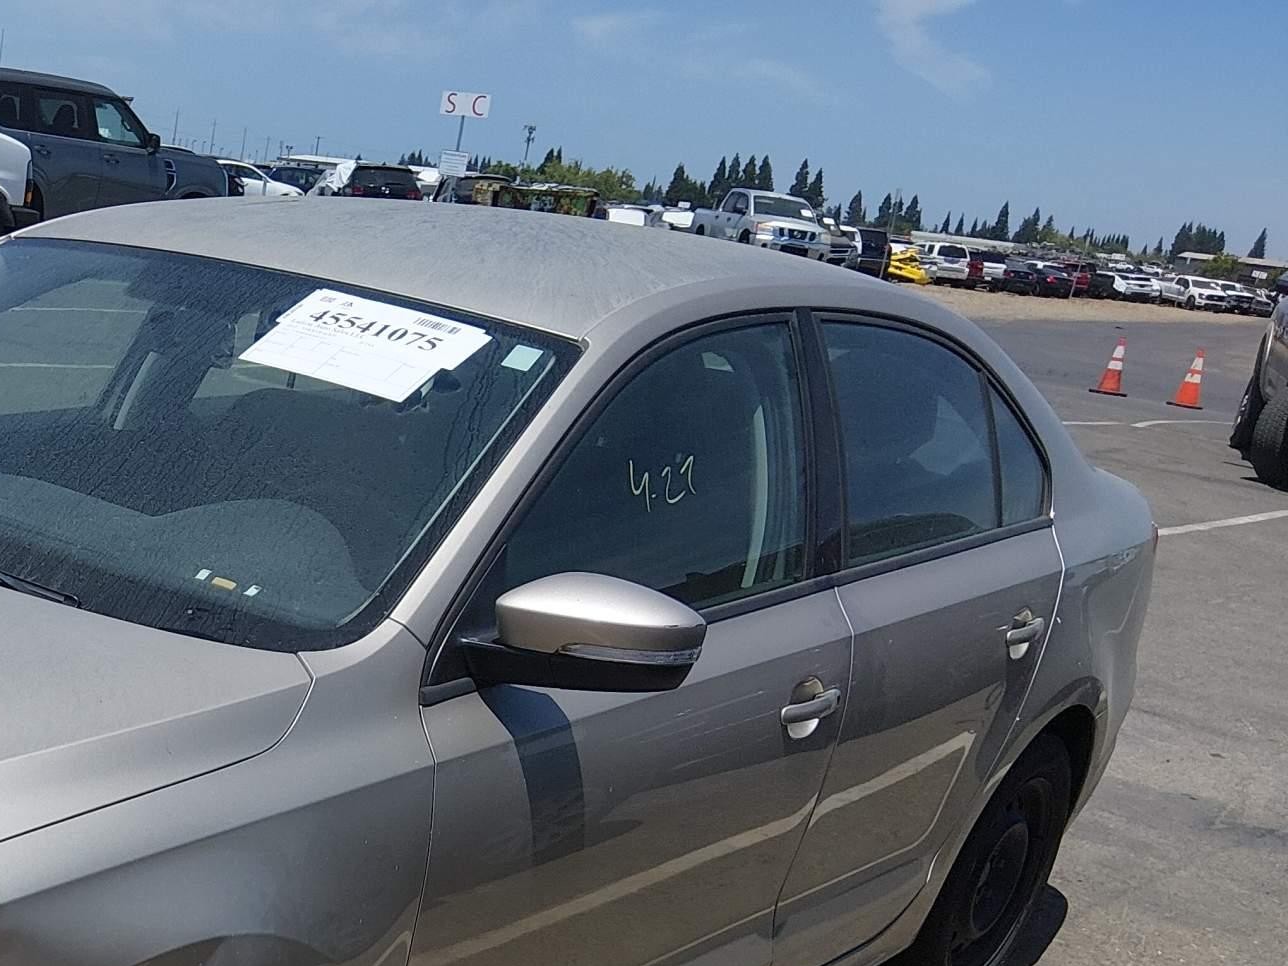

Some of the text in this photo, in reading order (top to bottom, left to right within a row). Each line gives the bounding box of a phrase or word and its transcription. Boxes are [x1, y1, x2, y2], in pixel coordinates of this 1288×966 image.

[445, 92, 486, 116] S C
[309, 310, 444, 351] 45541075
